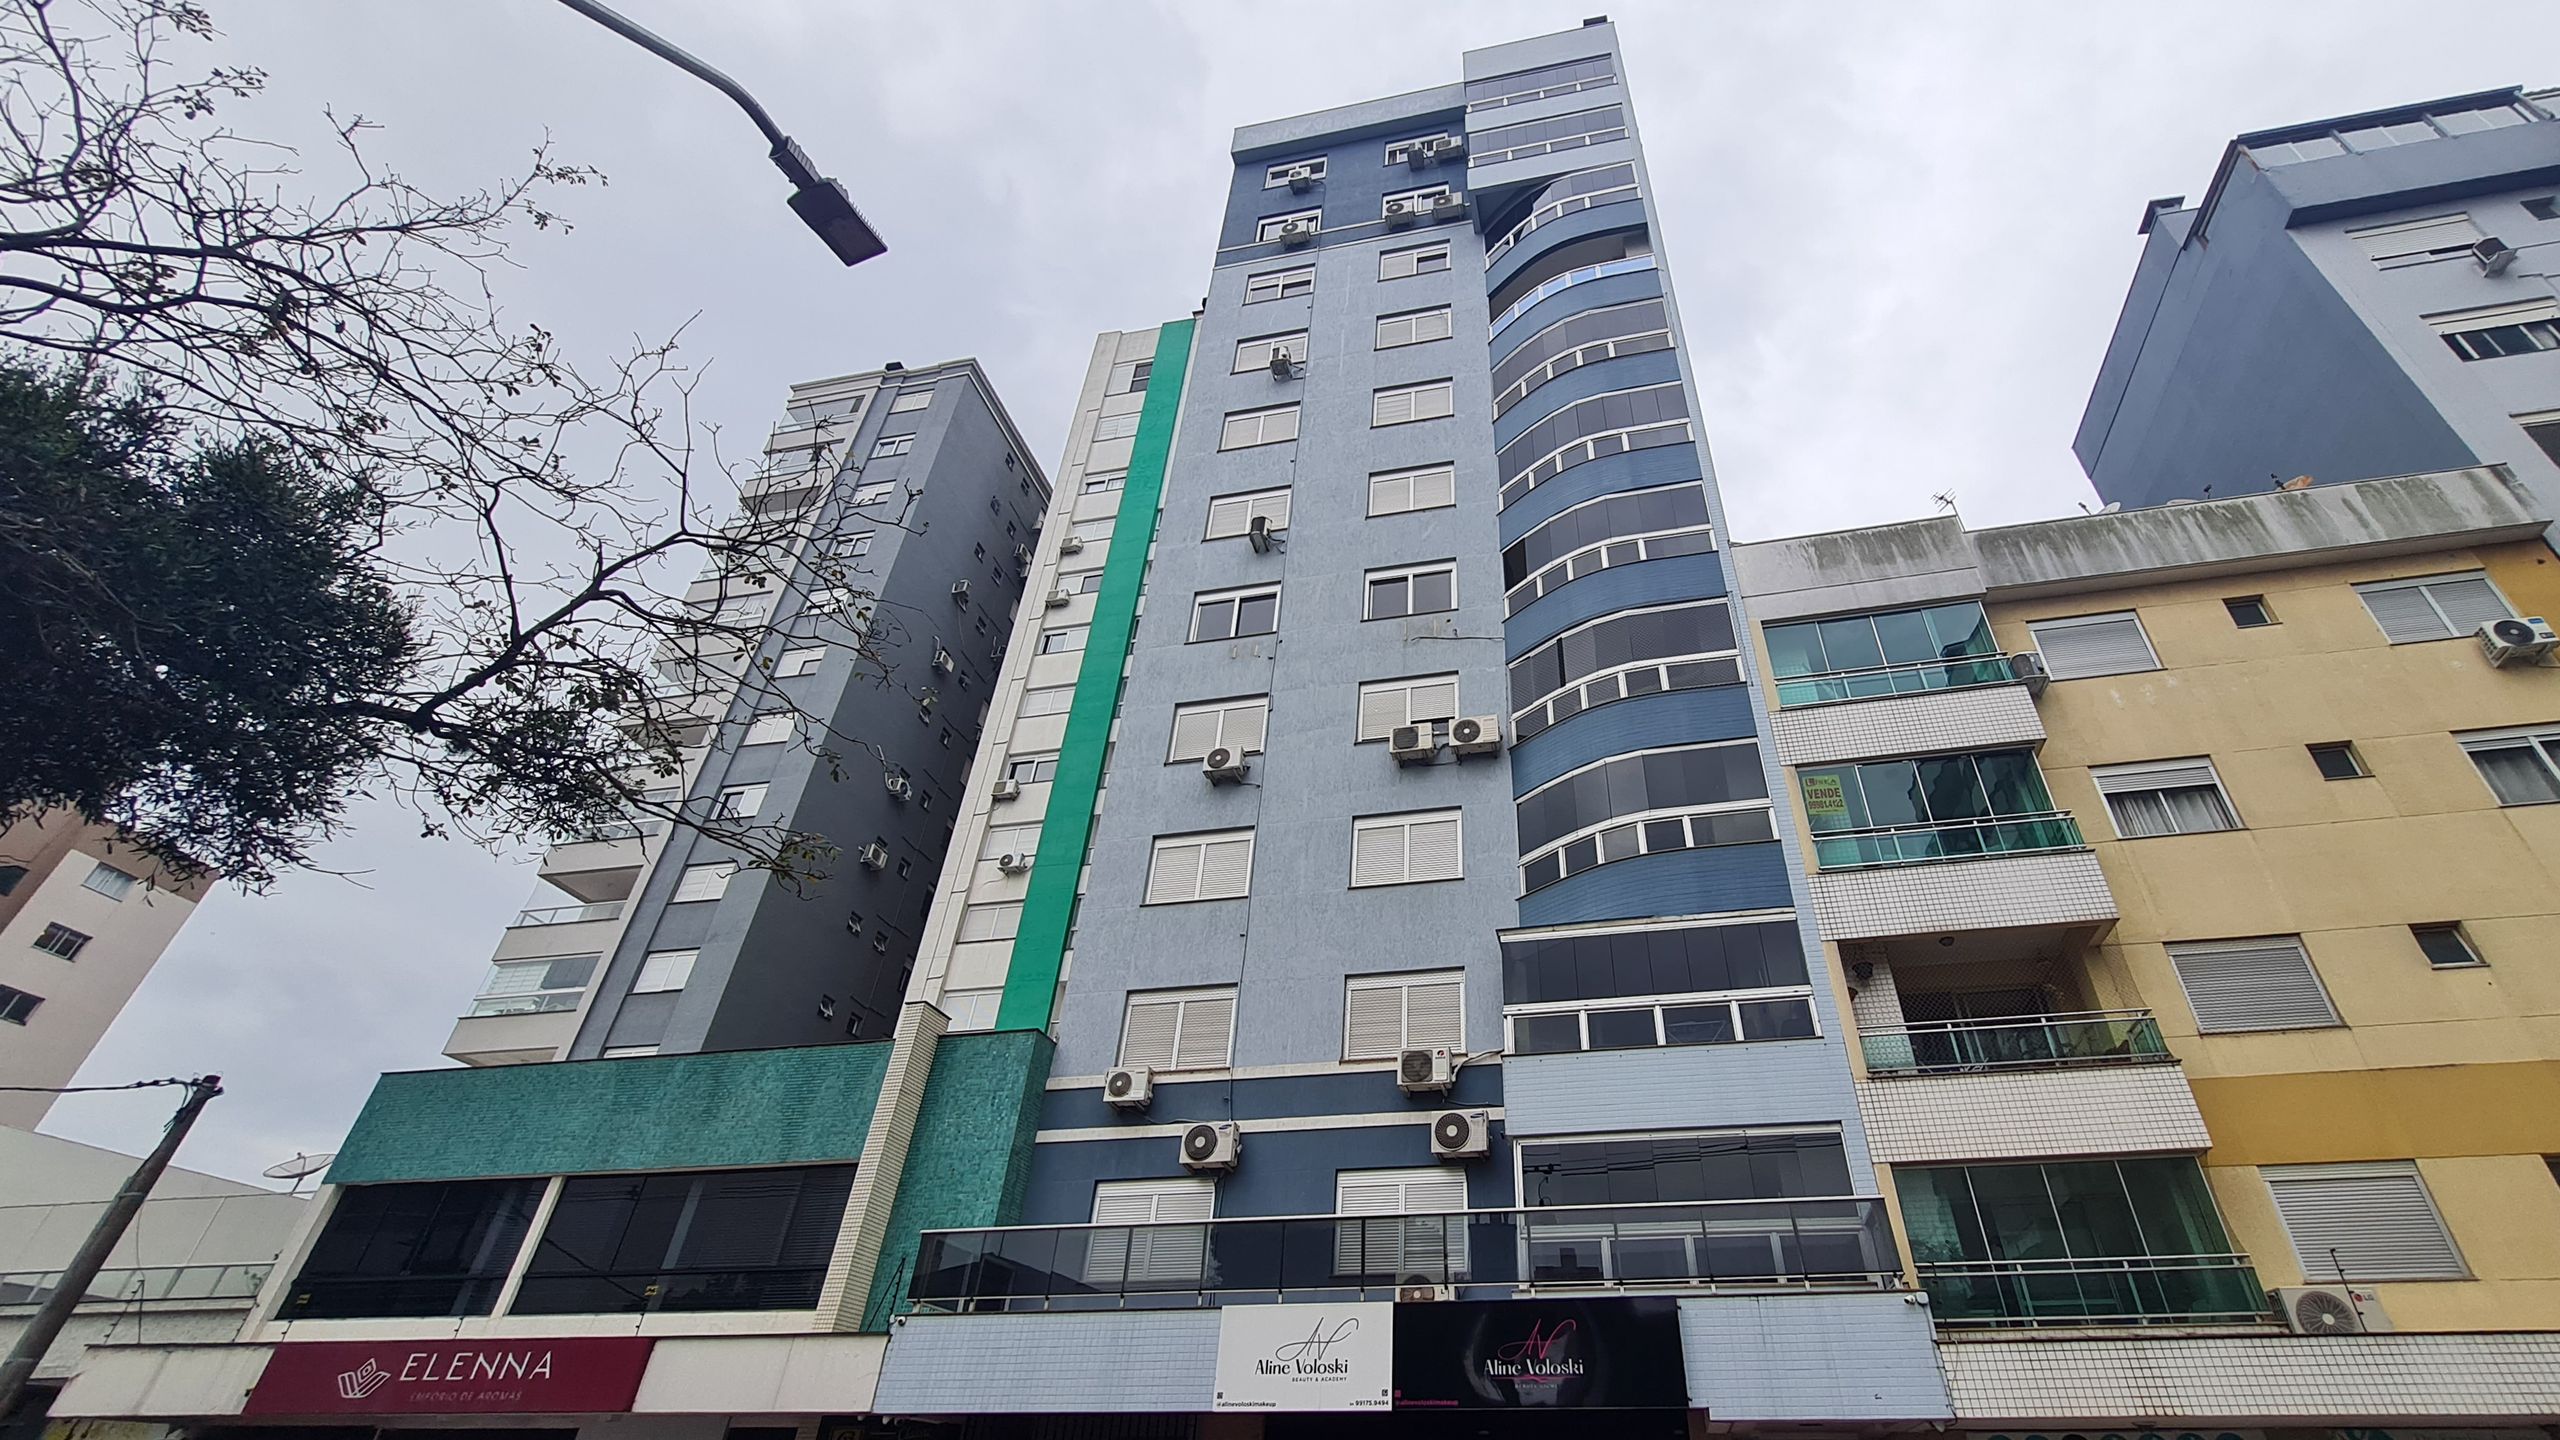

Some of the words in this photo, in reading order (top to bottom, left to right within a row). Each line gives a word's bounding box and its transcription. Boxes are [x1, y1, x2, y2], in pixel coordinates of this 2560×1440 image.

[1807, 788, 1841, 799] VENDE
[399, 1351, 551, 1380] ELENNA
[1255, 1359, 1291, 1375] Aline
[1296, 1358, 1349, 1375] Voloski
[1484, 1359, 1521, 1375] Aline
[1526, 1358, 1584, 1375] Voloski
